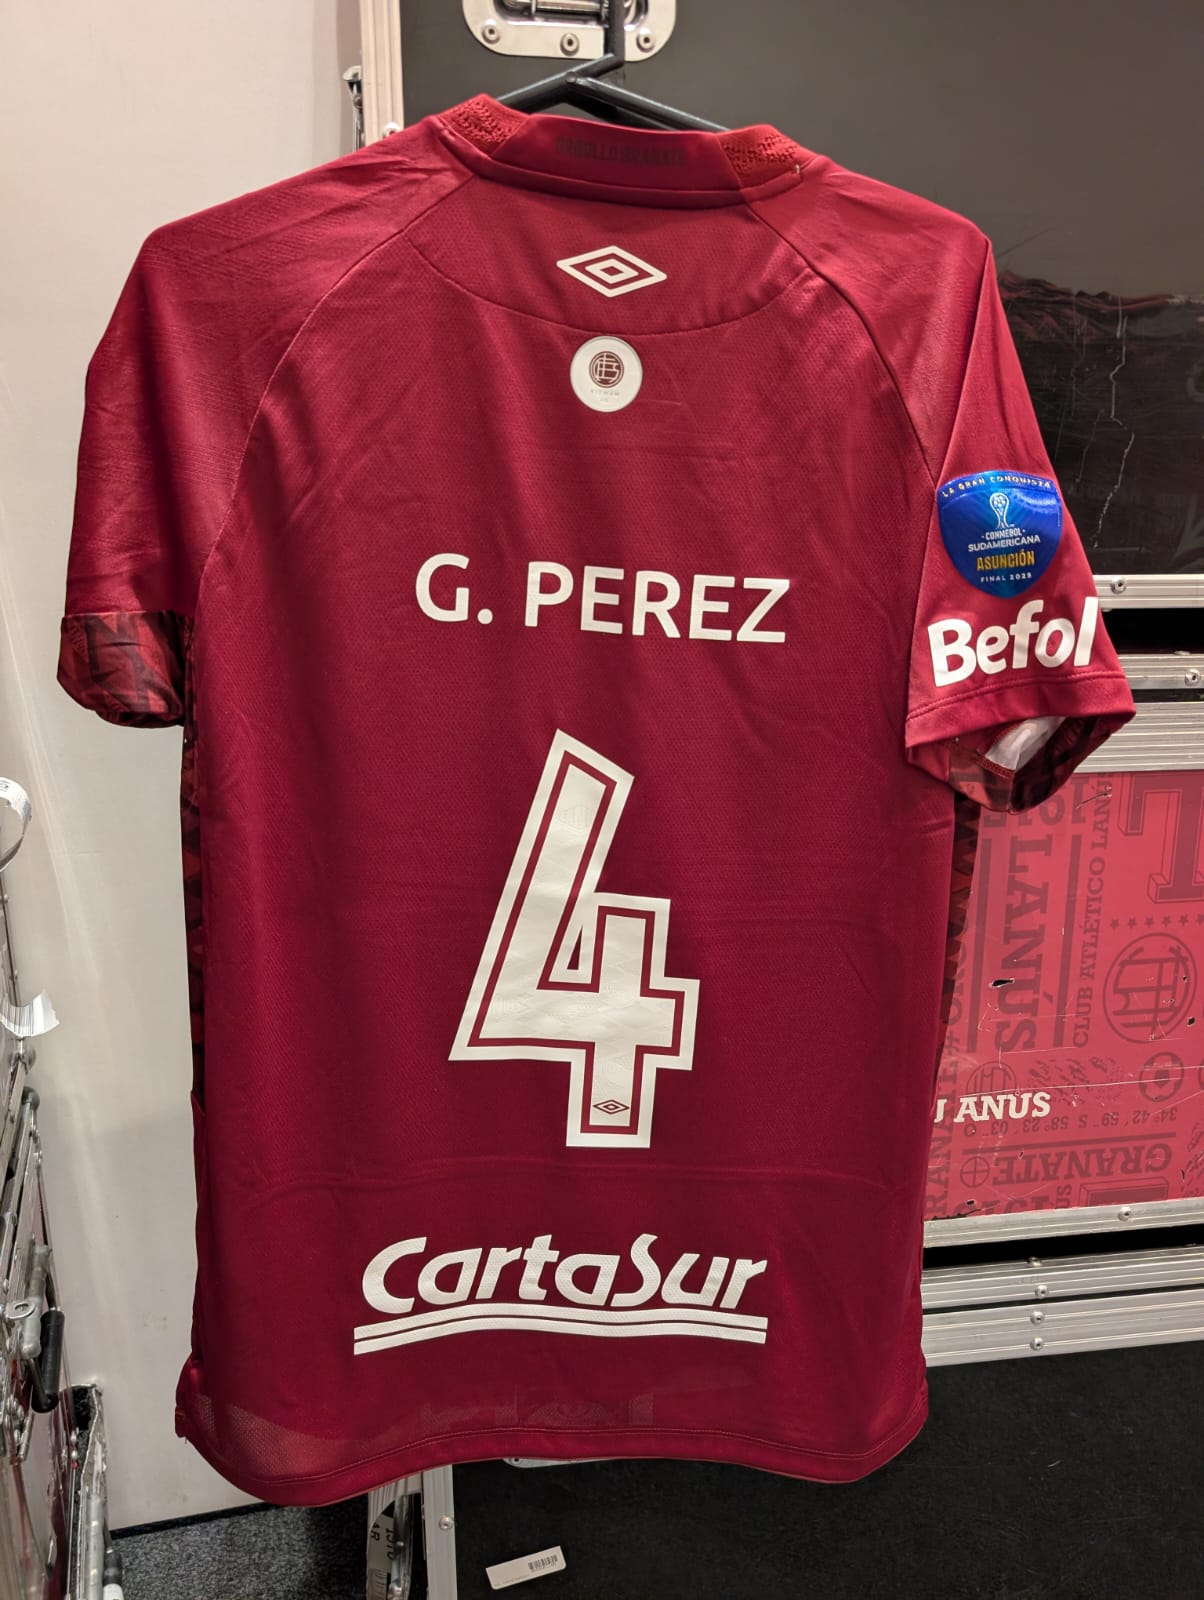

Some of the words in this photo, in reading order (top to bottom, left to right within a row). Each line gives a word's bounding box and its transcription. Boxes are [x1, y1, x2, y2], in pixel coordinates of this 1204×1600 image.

[958, 477, 985, 490] GRAN
[990, 475, 1052, 489] CONQUISTA
[968, 534, 1041, 553] SUDAMERICANA
[976, 548, 1036, 572] ASUNCIÓN
[985, 527, 1023, 540] CONMEBOL
[416, 553, 493, 624] G.
[525, 561, 790, 643] PEREZ
[980, 574, 1006, 583] FINAL
[927, 596, 1099, 688] Befol
[448, 729, 700, 1149] 4
[994, 834, 1054, 1053] LANÚS
[1079, 855, 1106, 981] ATLÉTICO
[1073, 986, 1094, 1048] CLUB
[991, 1143, 1173, 1186] GRANATE
[362, 1233, 768, 1314] CartaSur
